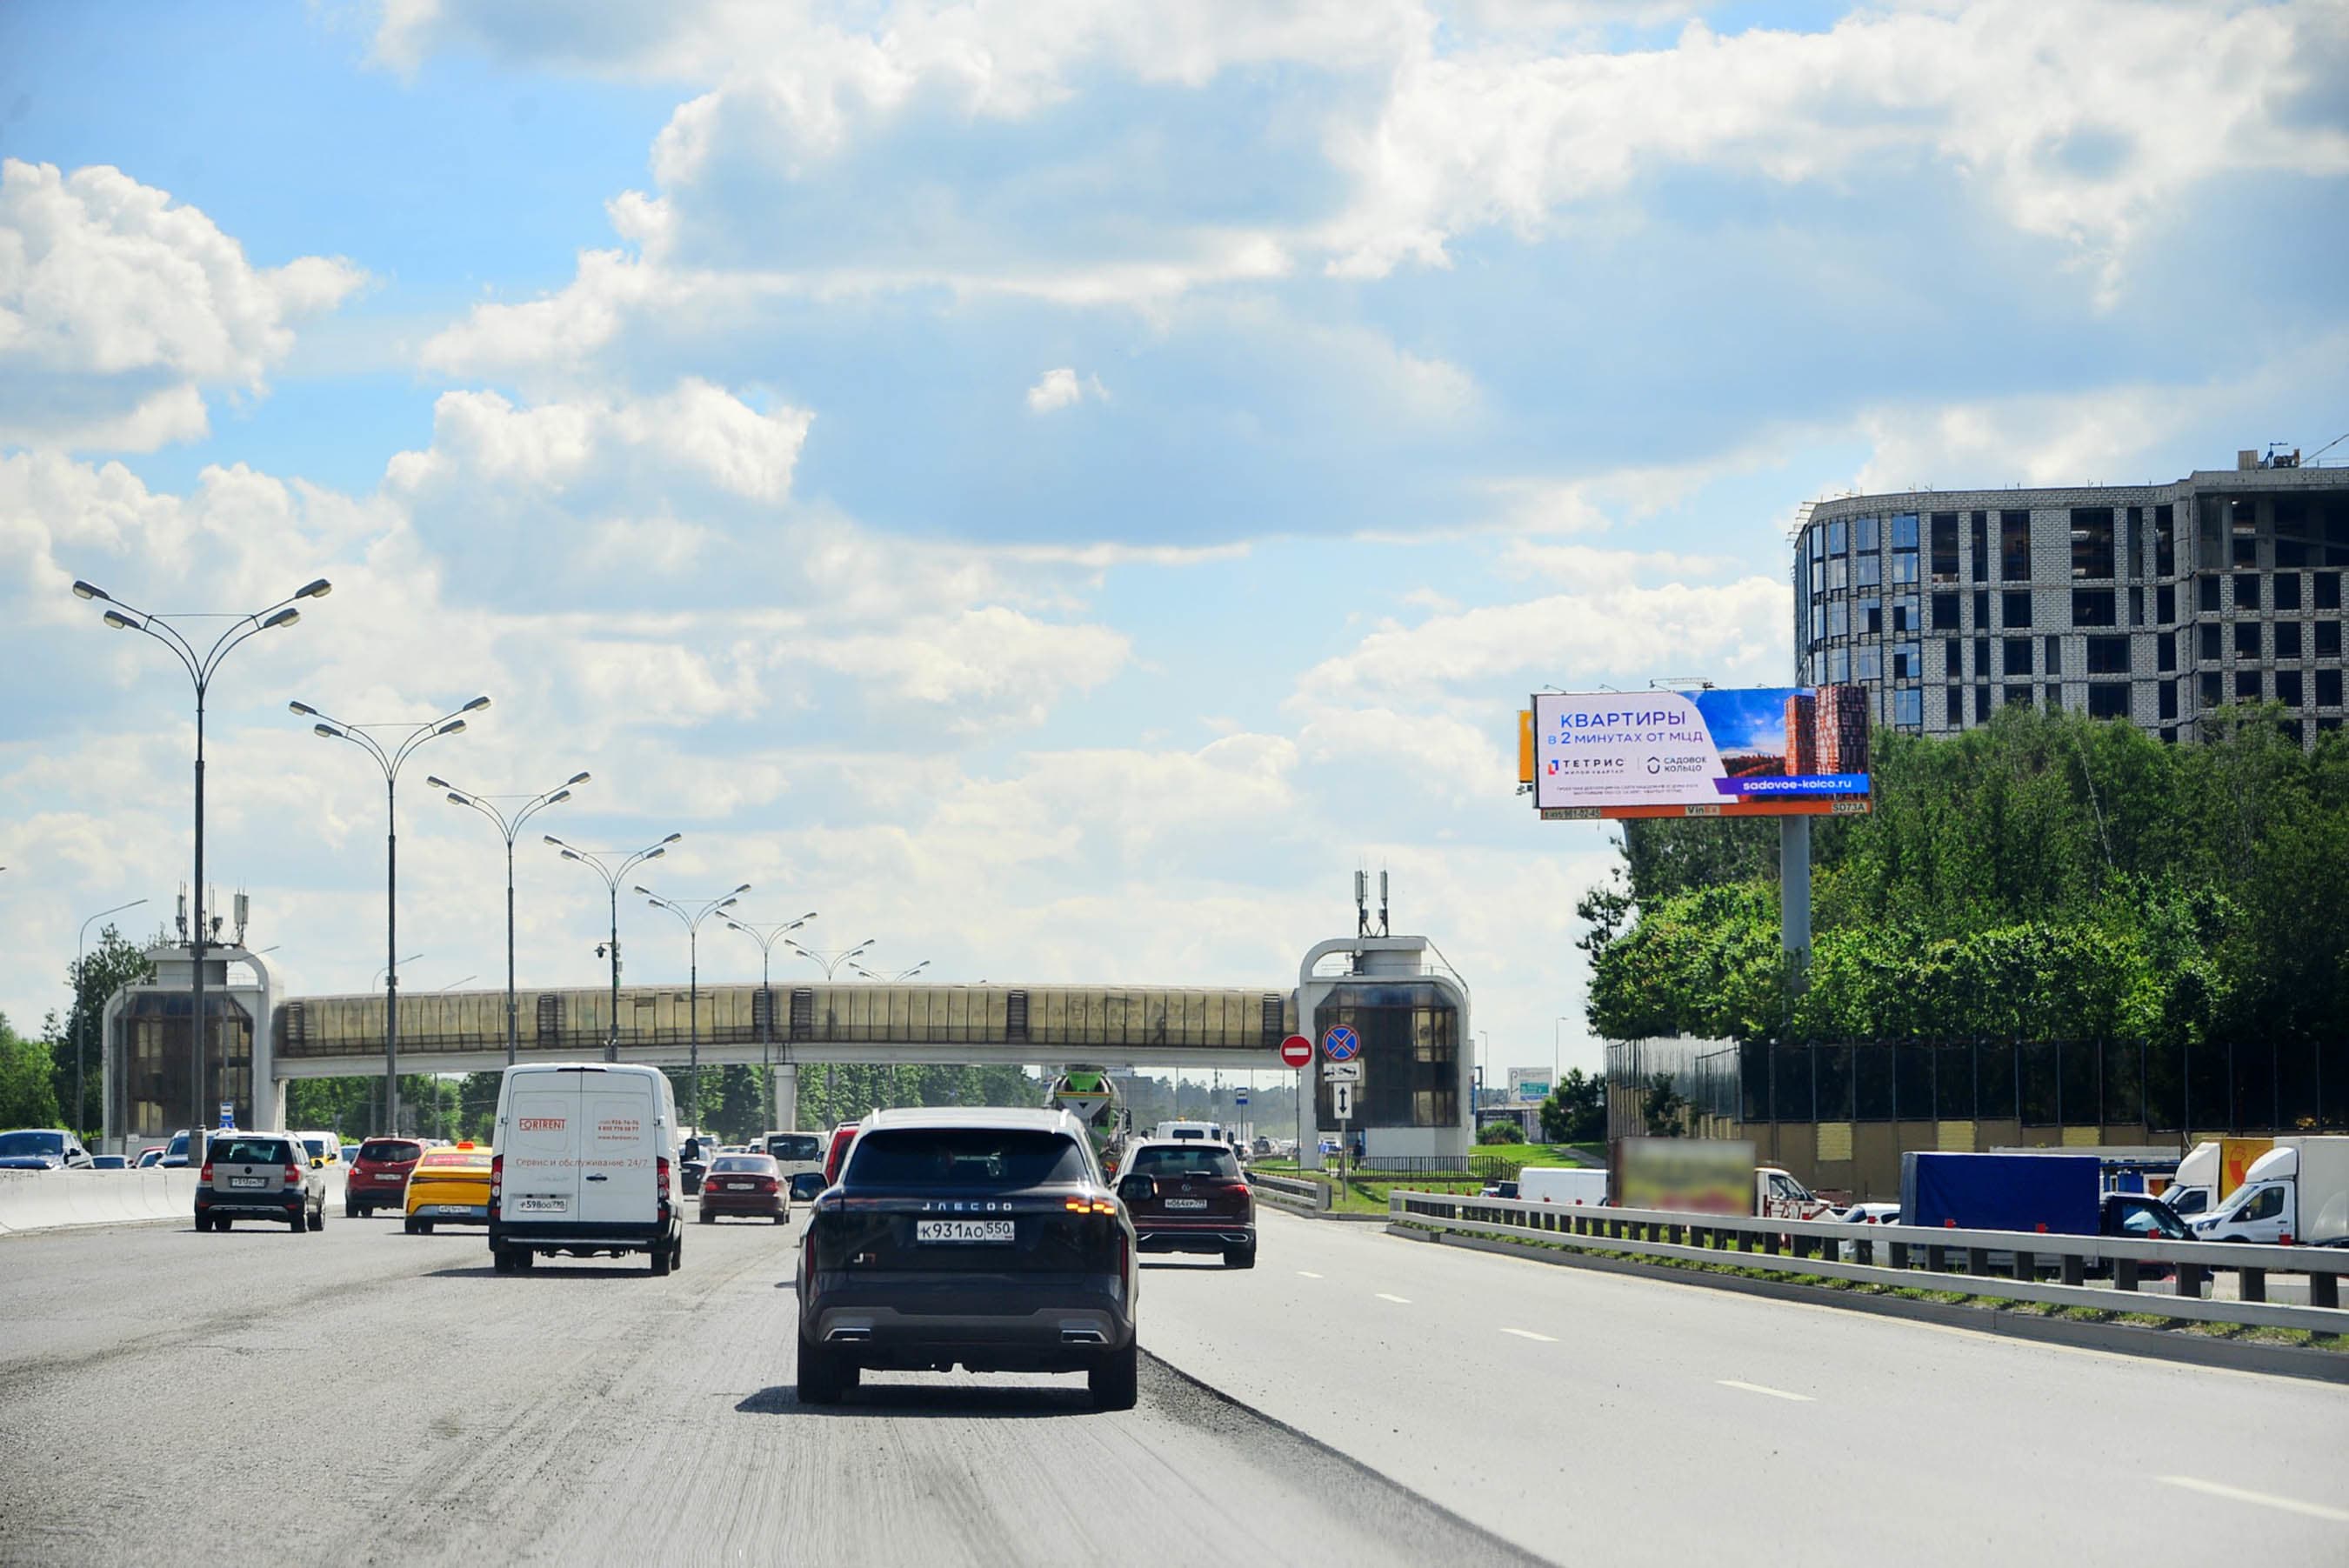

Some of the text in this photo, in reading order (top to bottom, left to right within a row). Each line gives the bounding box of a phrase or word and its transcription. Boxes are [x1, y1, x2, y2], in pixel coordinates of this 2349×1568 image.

[1560, 711, 1685, 728] КВАРТИРЫ
[1560, 731, 1571, 744] 2
[1574, 733, 1642, 744] МИНУТАХ
[1646, 732, 1665, 743] ОТ
[1669, 731, 1704, 744] МЦД
[1563, 757, 1625, 768] ТЕТРИС
[1663, 756, 1707, 765] САДОВОЕ
[1664, 764, 1703, 773] КОЛЬЦО
[1743, 779, 1852, 791] sadovoe-kolco.ru
[1832, 803, 1865, 811] SD73A
[516, 1158, 550, 1168] Сервис
[558, 1158, 624, 1168] обслуживание
[627, 1158, 648, 1169] 24/7
